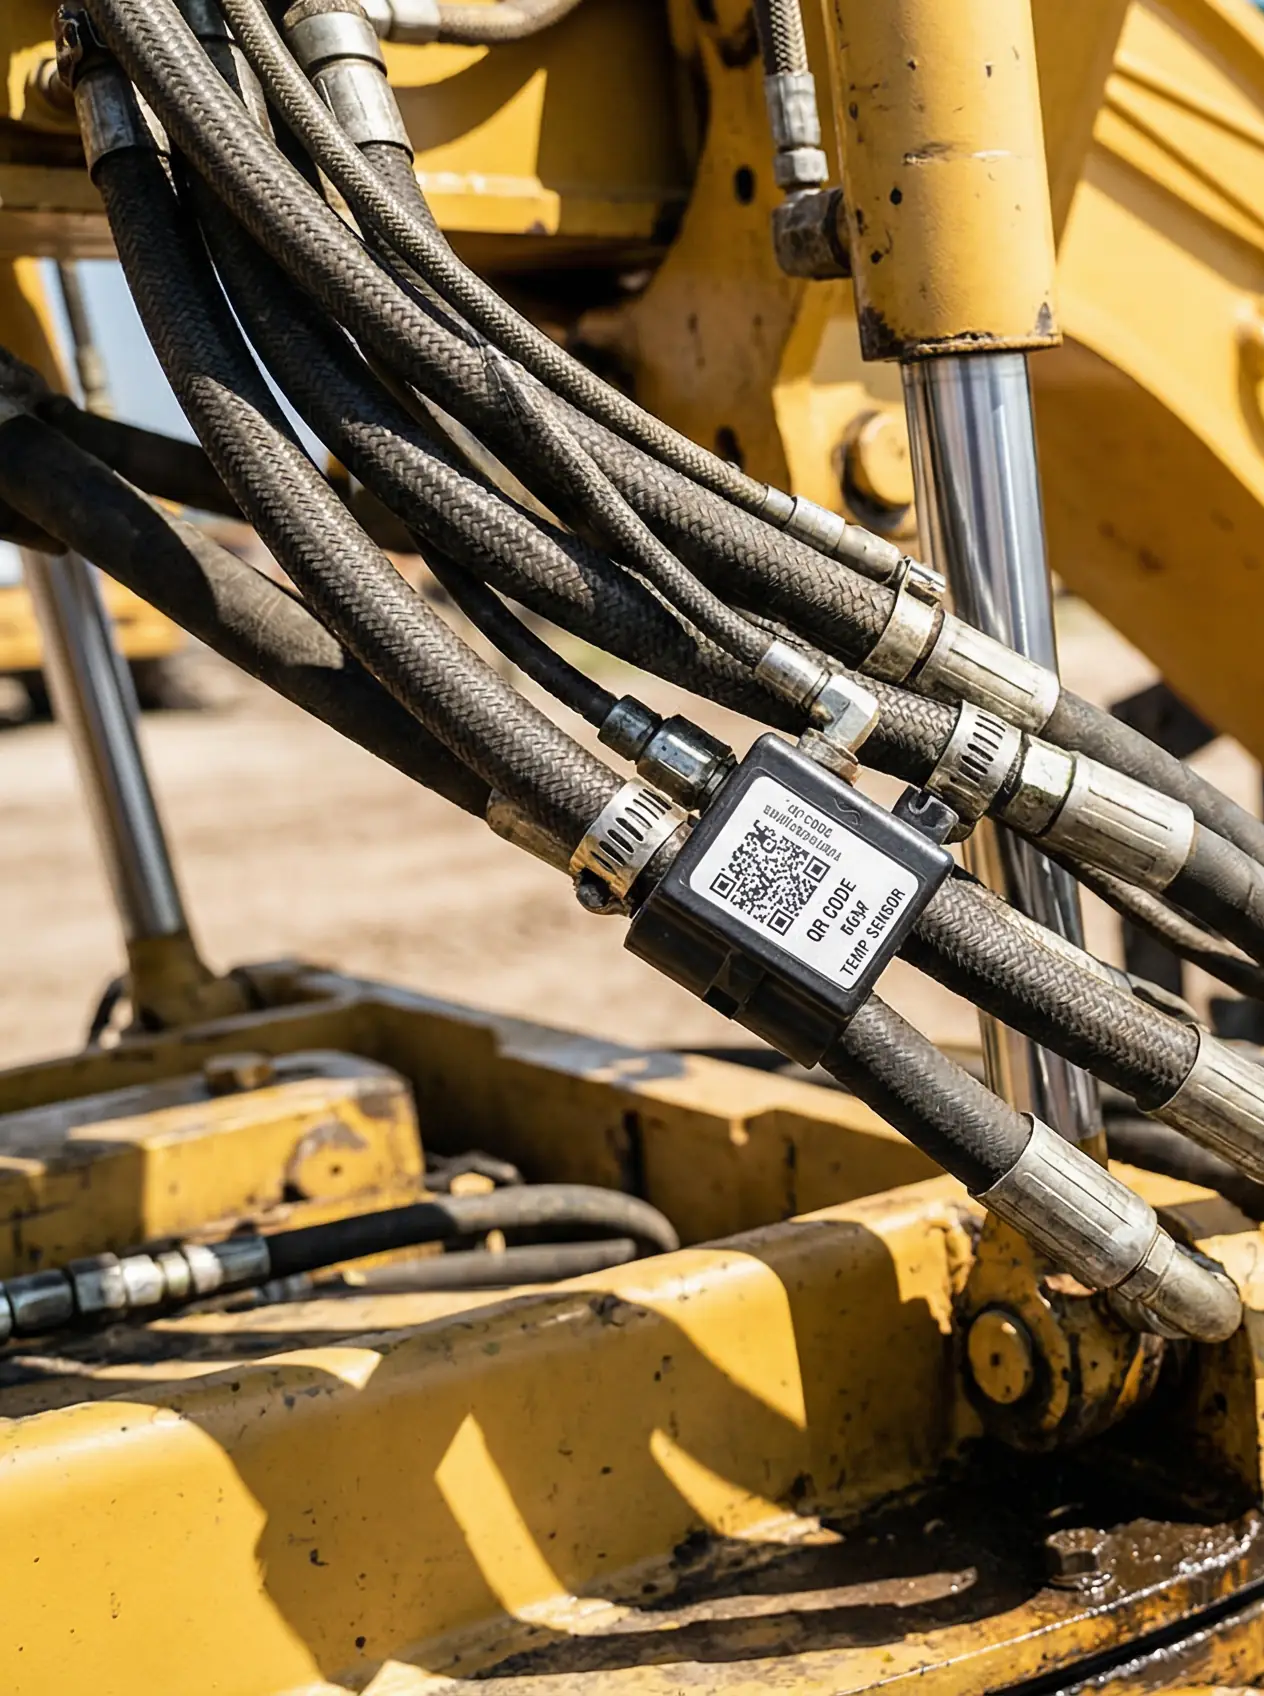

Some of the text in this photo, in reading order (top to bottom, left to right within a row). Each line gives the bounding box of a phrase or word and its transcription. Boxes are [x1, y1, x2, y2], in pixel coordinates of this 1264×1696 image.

[806, 918, 830, 942] QR
[822, 877, 857, 919] CODE
[839, 939, 870, 976] TEMP
